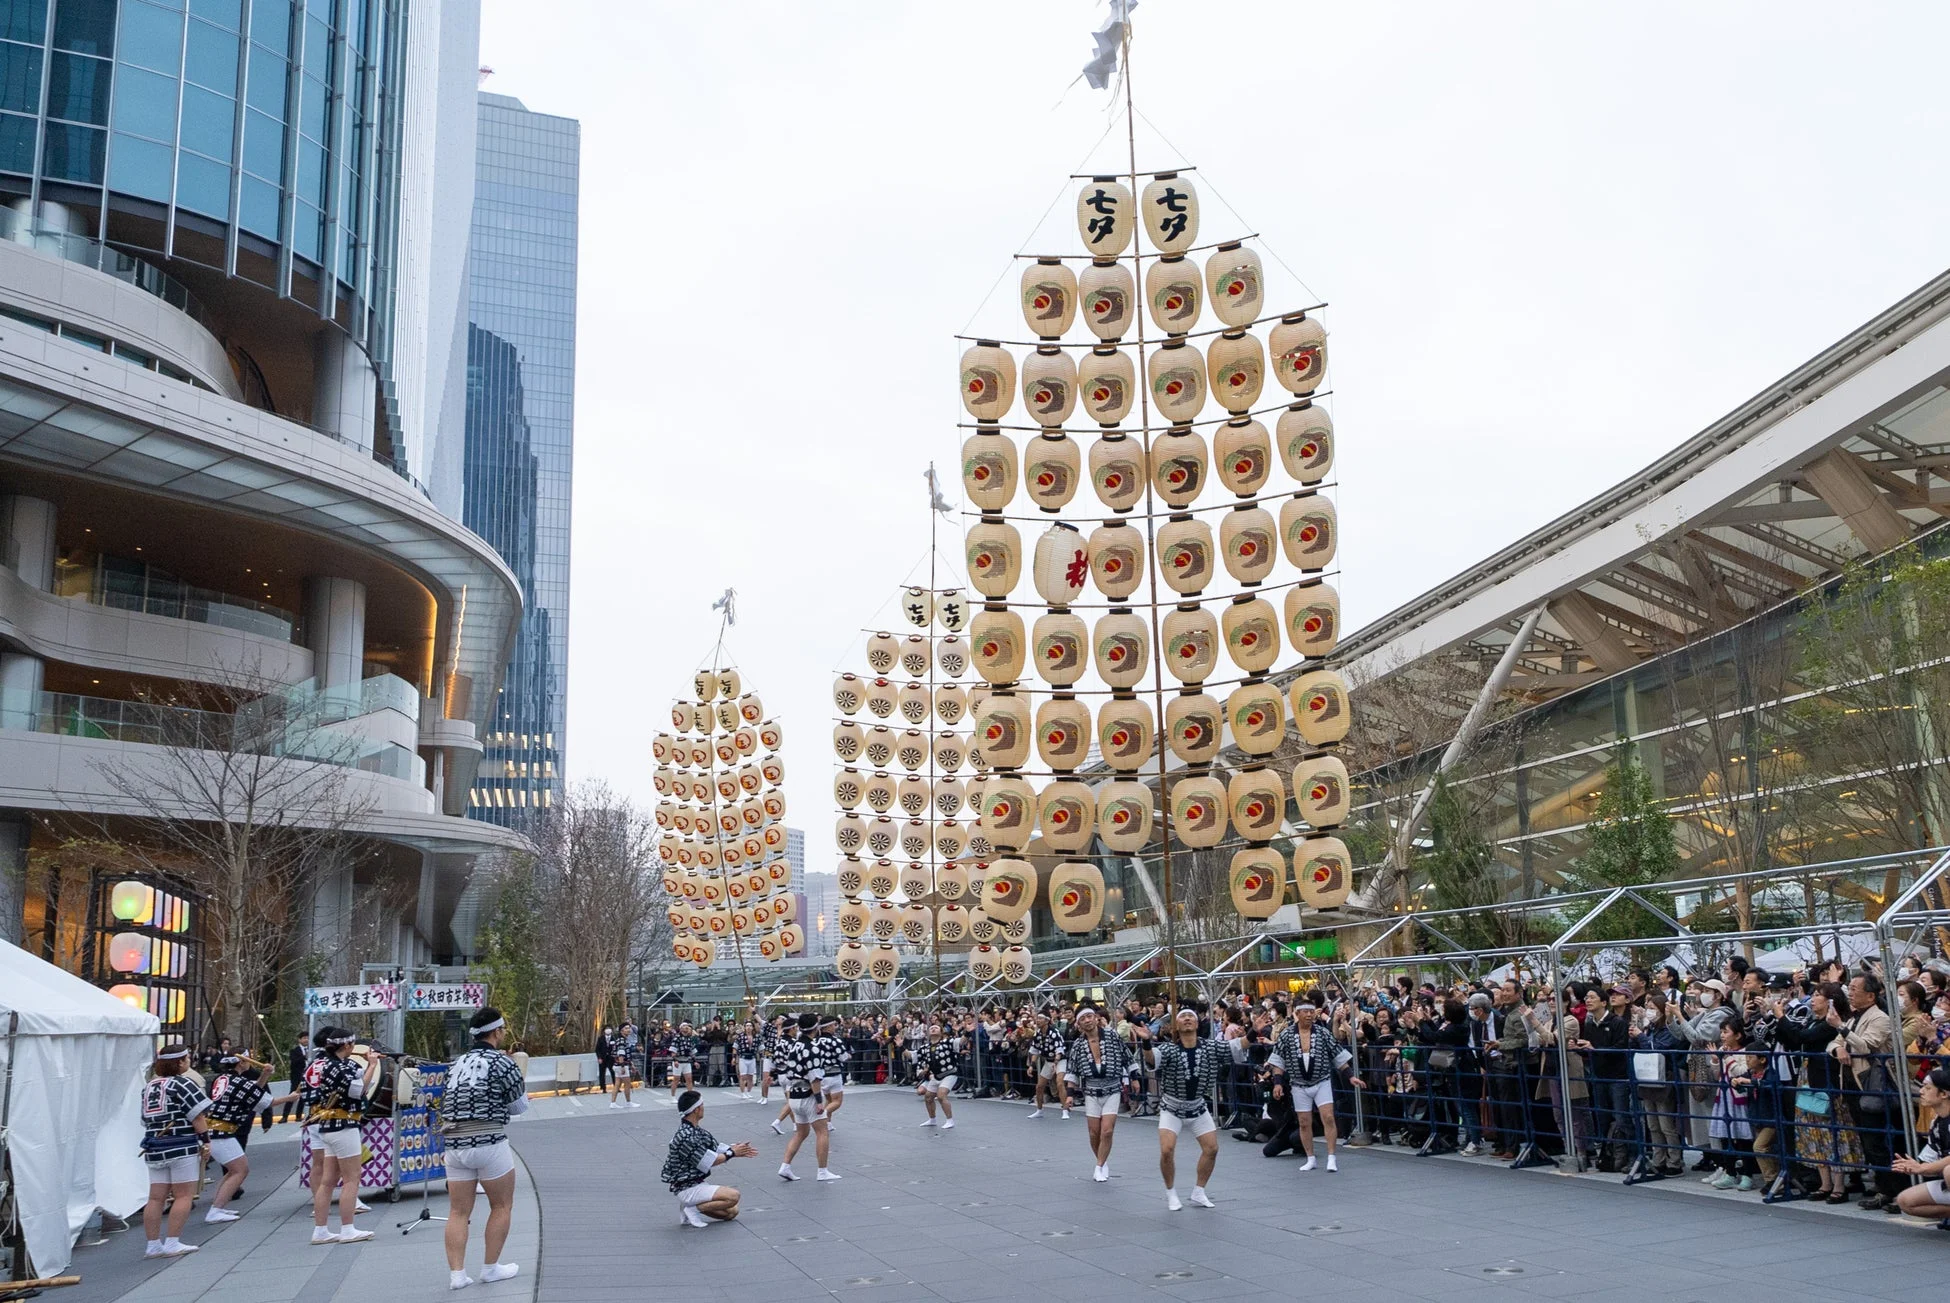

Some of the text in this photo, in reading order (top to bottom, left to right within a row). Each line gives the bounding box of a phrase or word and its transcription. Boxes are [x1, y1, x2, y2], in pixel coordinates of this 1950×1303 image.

[1085, 188, 1118, 244] 七夕
[1156, 187, 1188, 243] 七夕
[907, 603, 925, 625] 七夕
[943, 603, 961, 627] 七夕
[308, 989, 393, 1009] 秋田竿燈まつり
